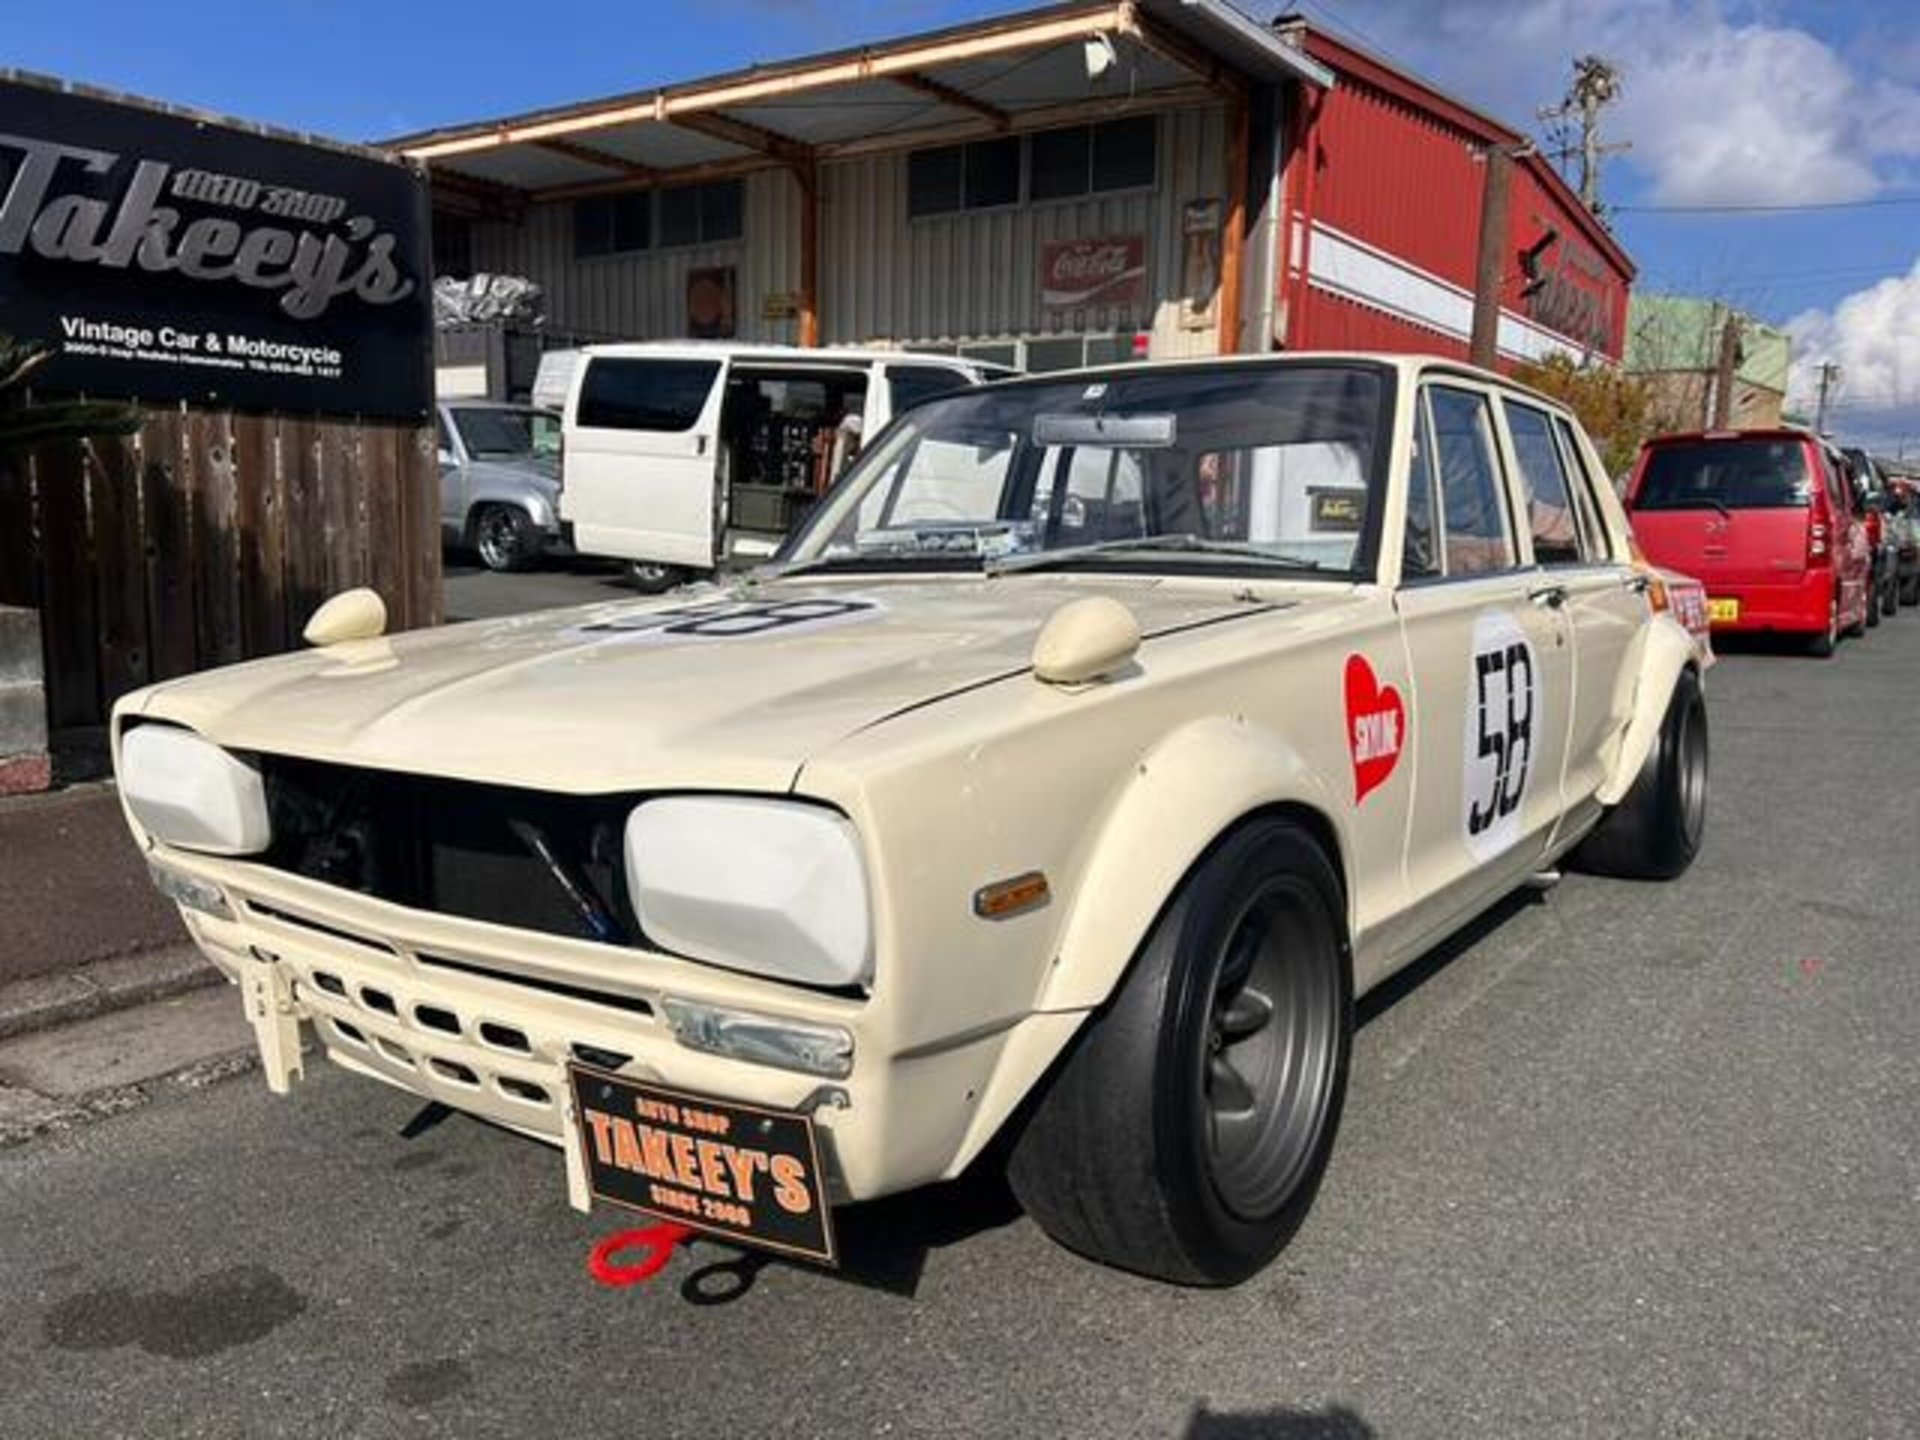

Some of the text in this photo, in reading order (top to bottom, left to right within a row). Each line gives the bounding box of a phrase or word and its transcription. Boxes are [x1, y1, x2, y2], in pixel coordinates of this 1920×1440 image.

[61, 316, 153, 348] Vintage
[159, 327, 199, 349] Car
[205, 333, 221, 352] &
[227, 335, 342, 365] Motorcycle
[1469, 642, 1533, 835] 58
[584, 1108, 812, 1213] TAKEEY'S
